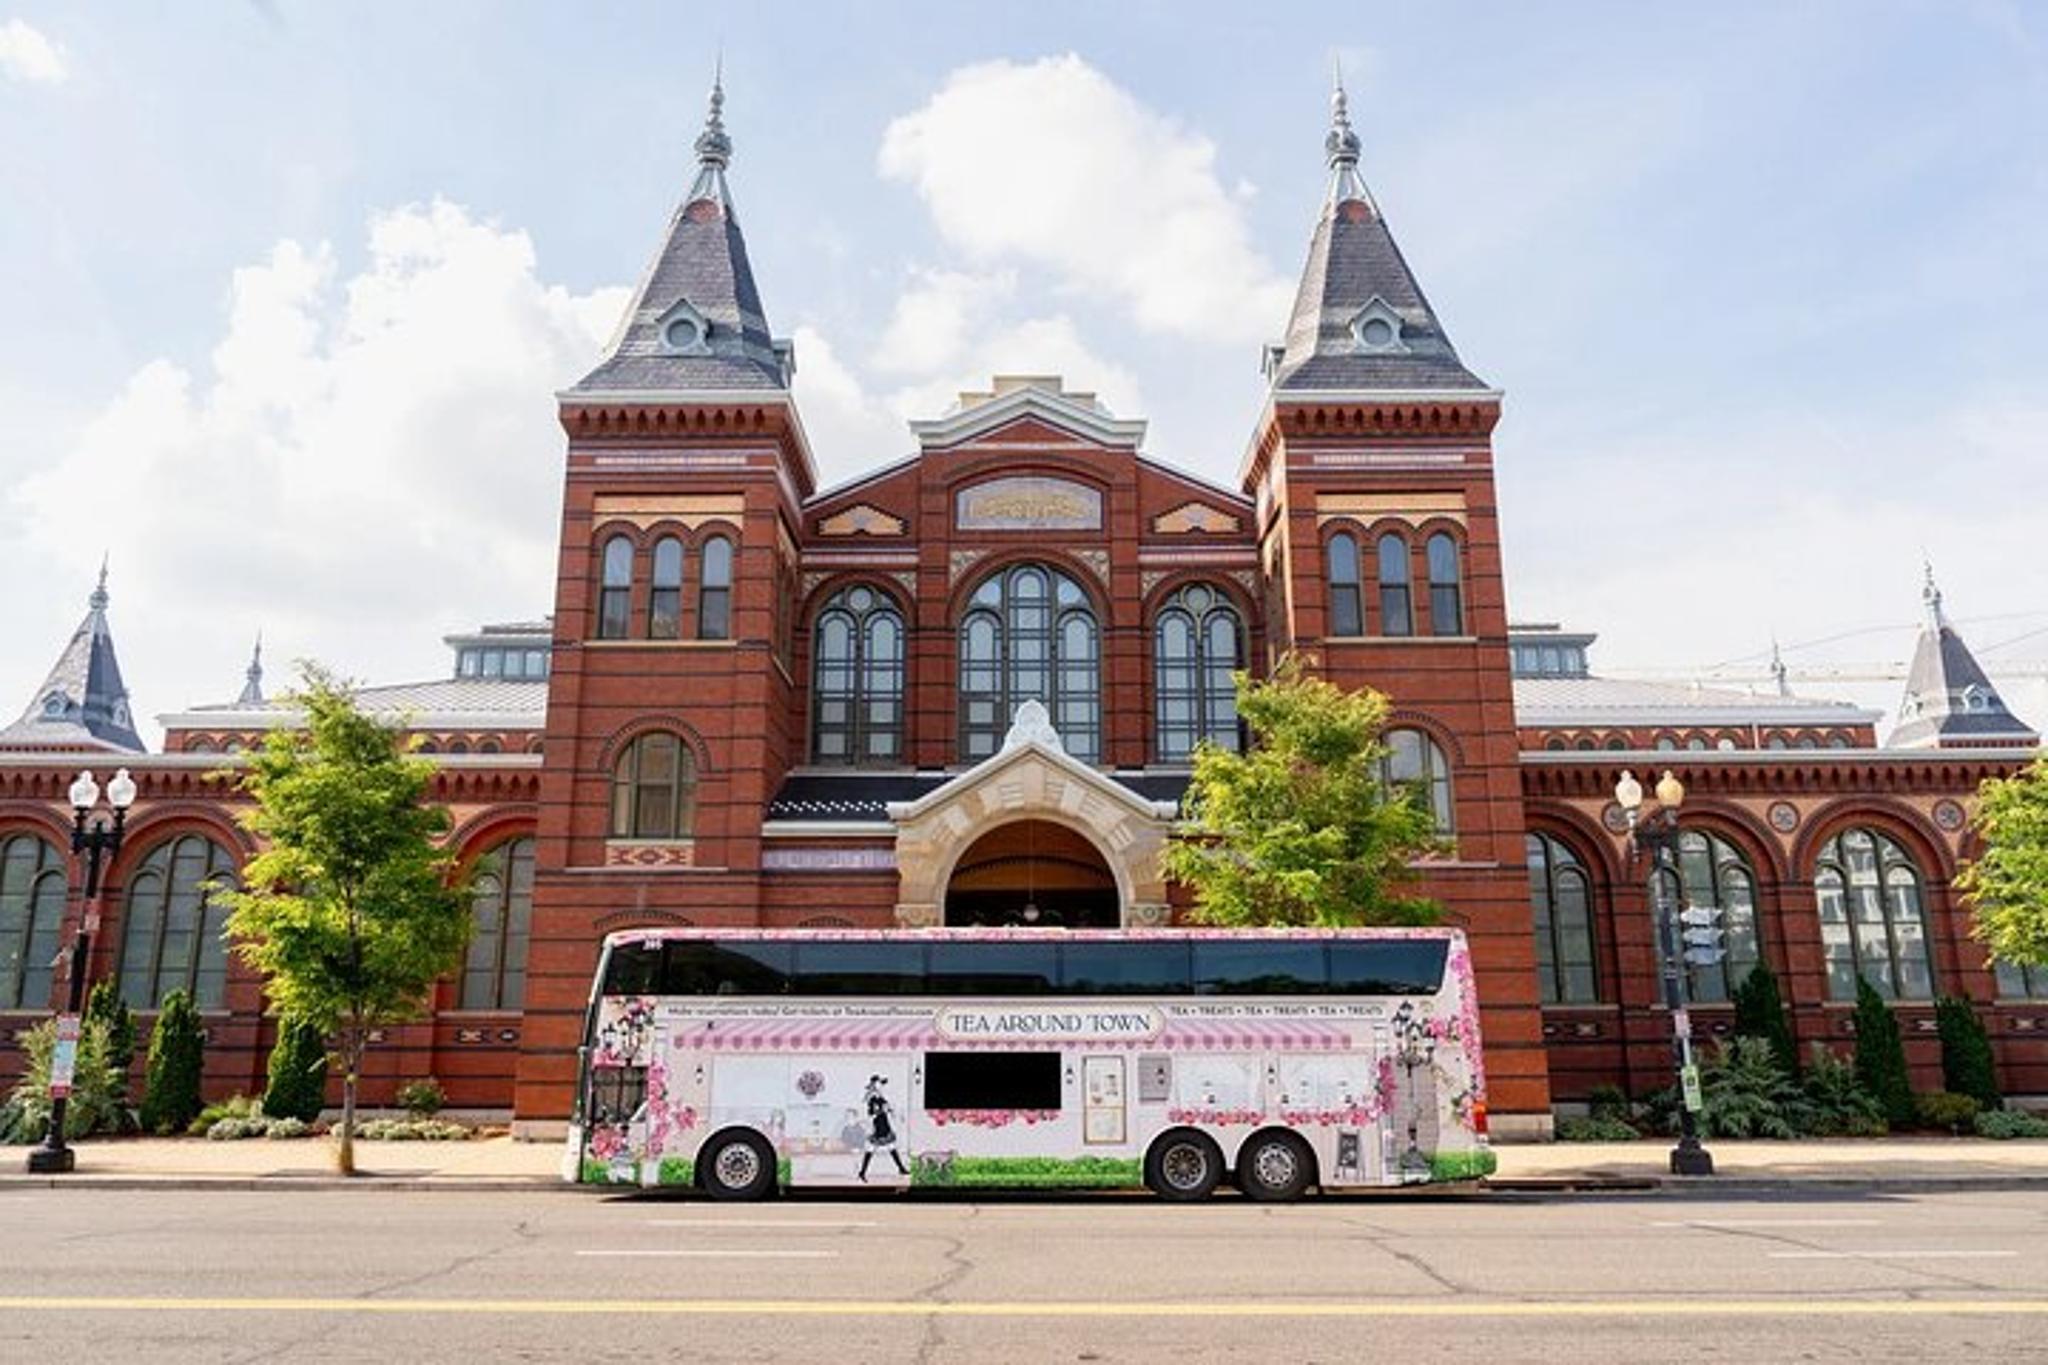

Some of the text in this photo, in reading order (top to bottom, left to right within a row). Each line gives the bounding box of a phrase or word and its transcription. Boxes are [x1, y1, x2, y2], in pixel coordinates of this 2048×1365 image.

[1171, 1006, 1383, 1015] TEA TREATS TEA TREATS TEA TREATS
[952, 1014, 1150, 1032] TEA AROUND TOWN
